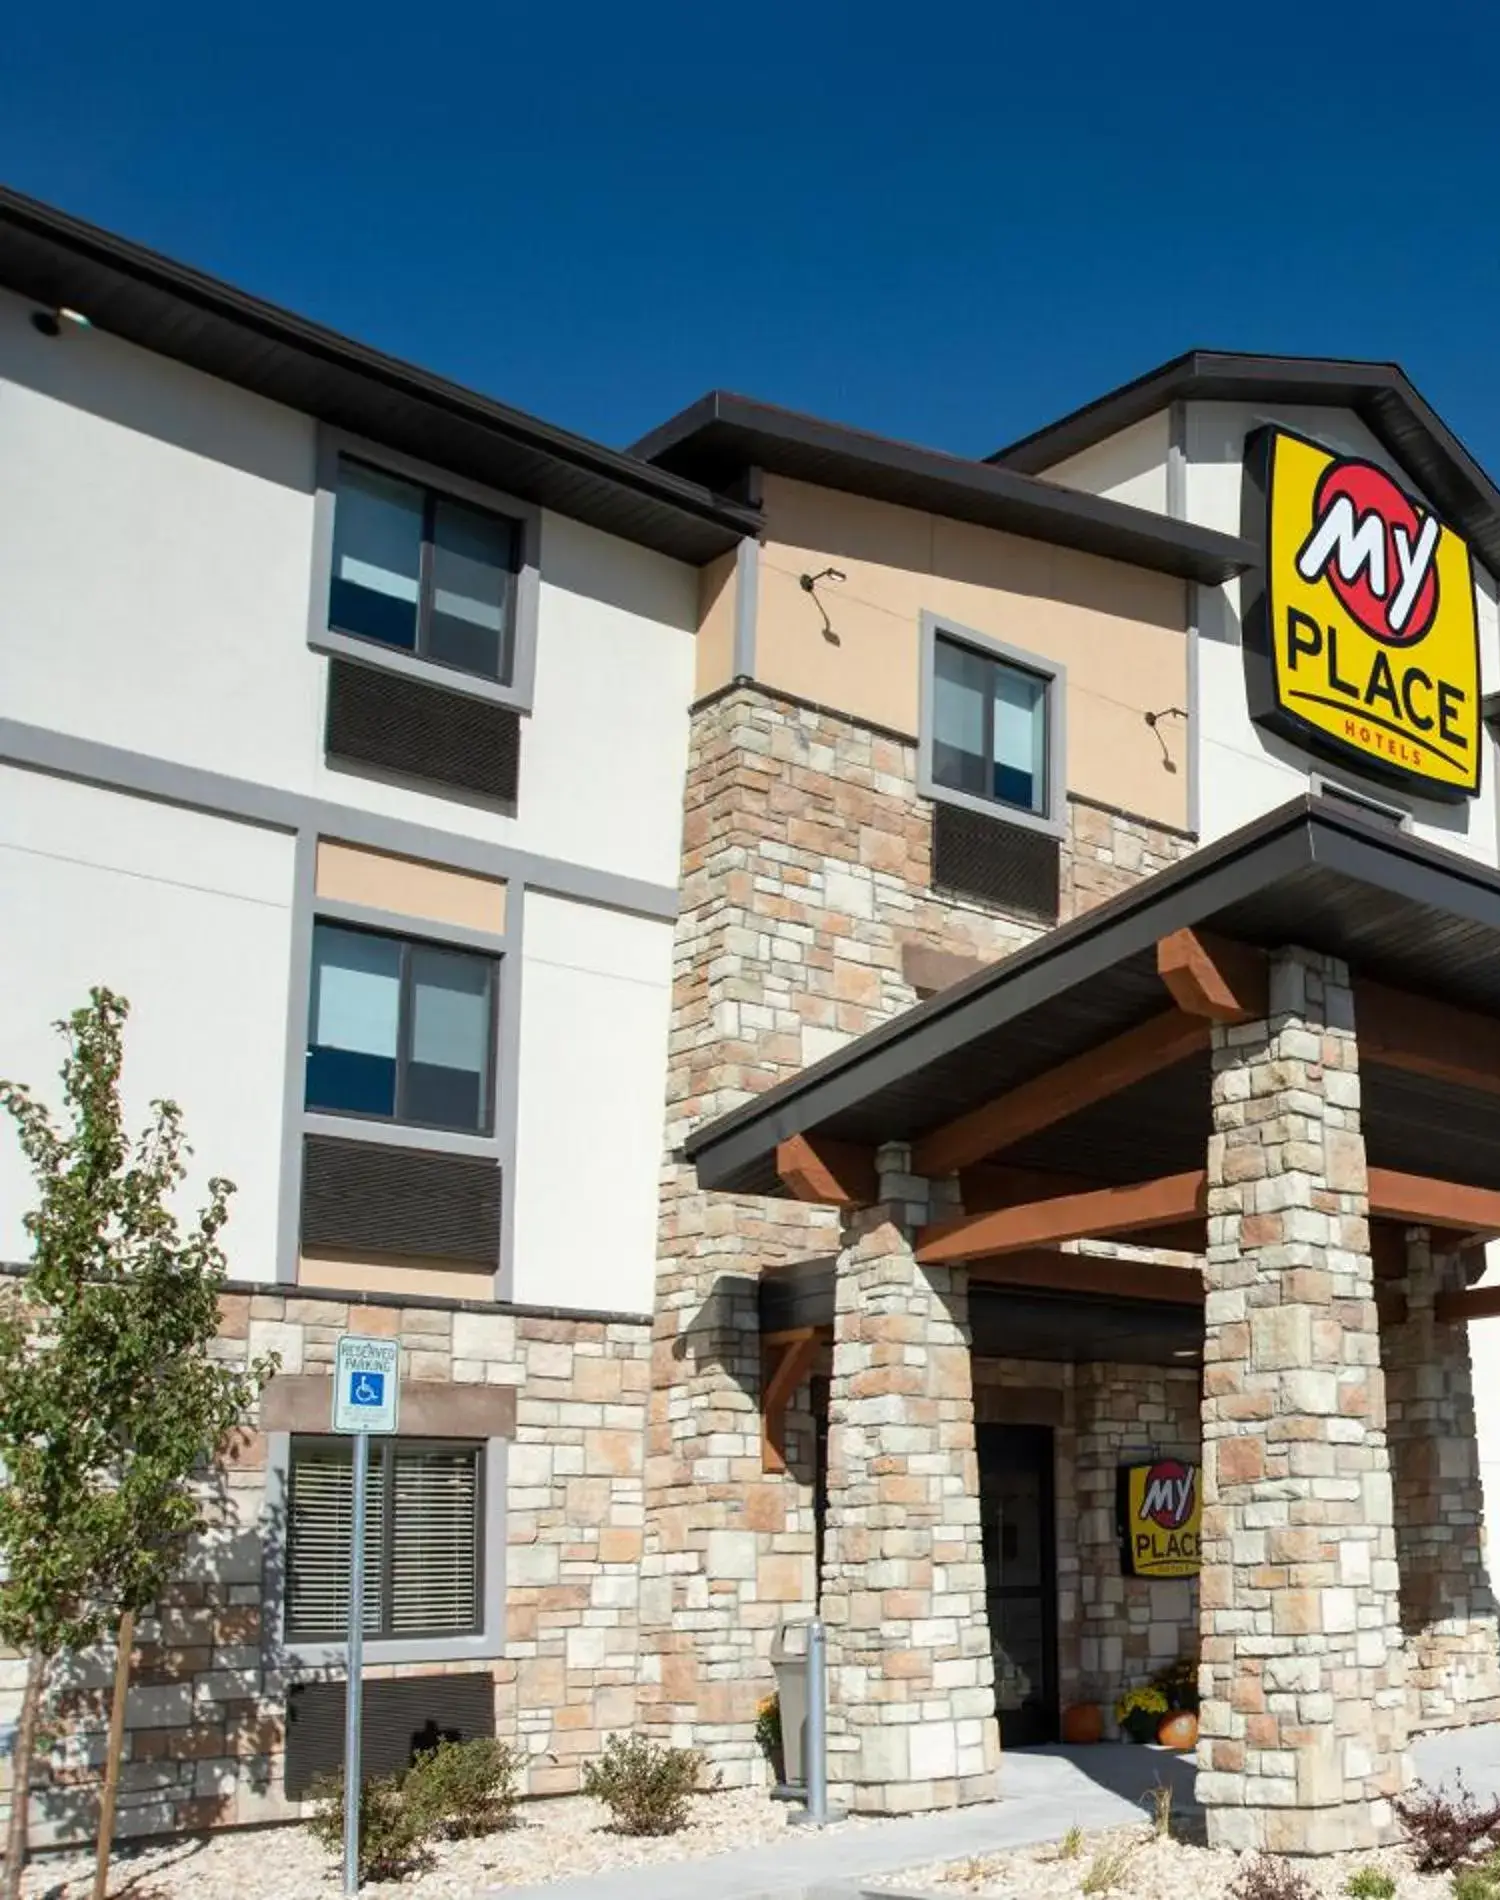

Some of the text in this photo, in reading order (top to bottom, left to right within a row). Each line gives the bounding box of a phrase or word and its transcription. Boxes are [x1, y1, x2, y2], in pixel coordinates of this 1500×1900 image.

[1286, 605, 1468, 749] PLACE
[1344, 719, 1421, 766] HOTELS
[341, 1344, 395, 1360] RESERVED
[344, 1358, 391, 1372] PARKING
